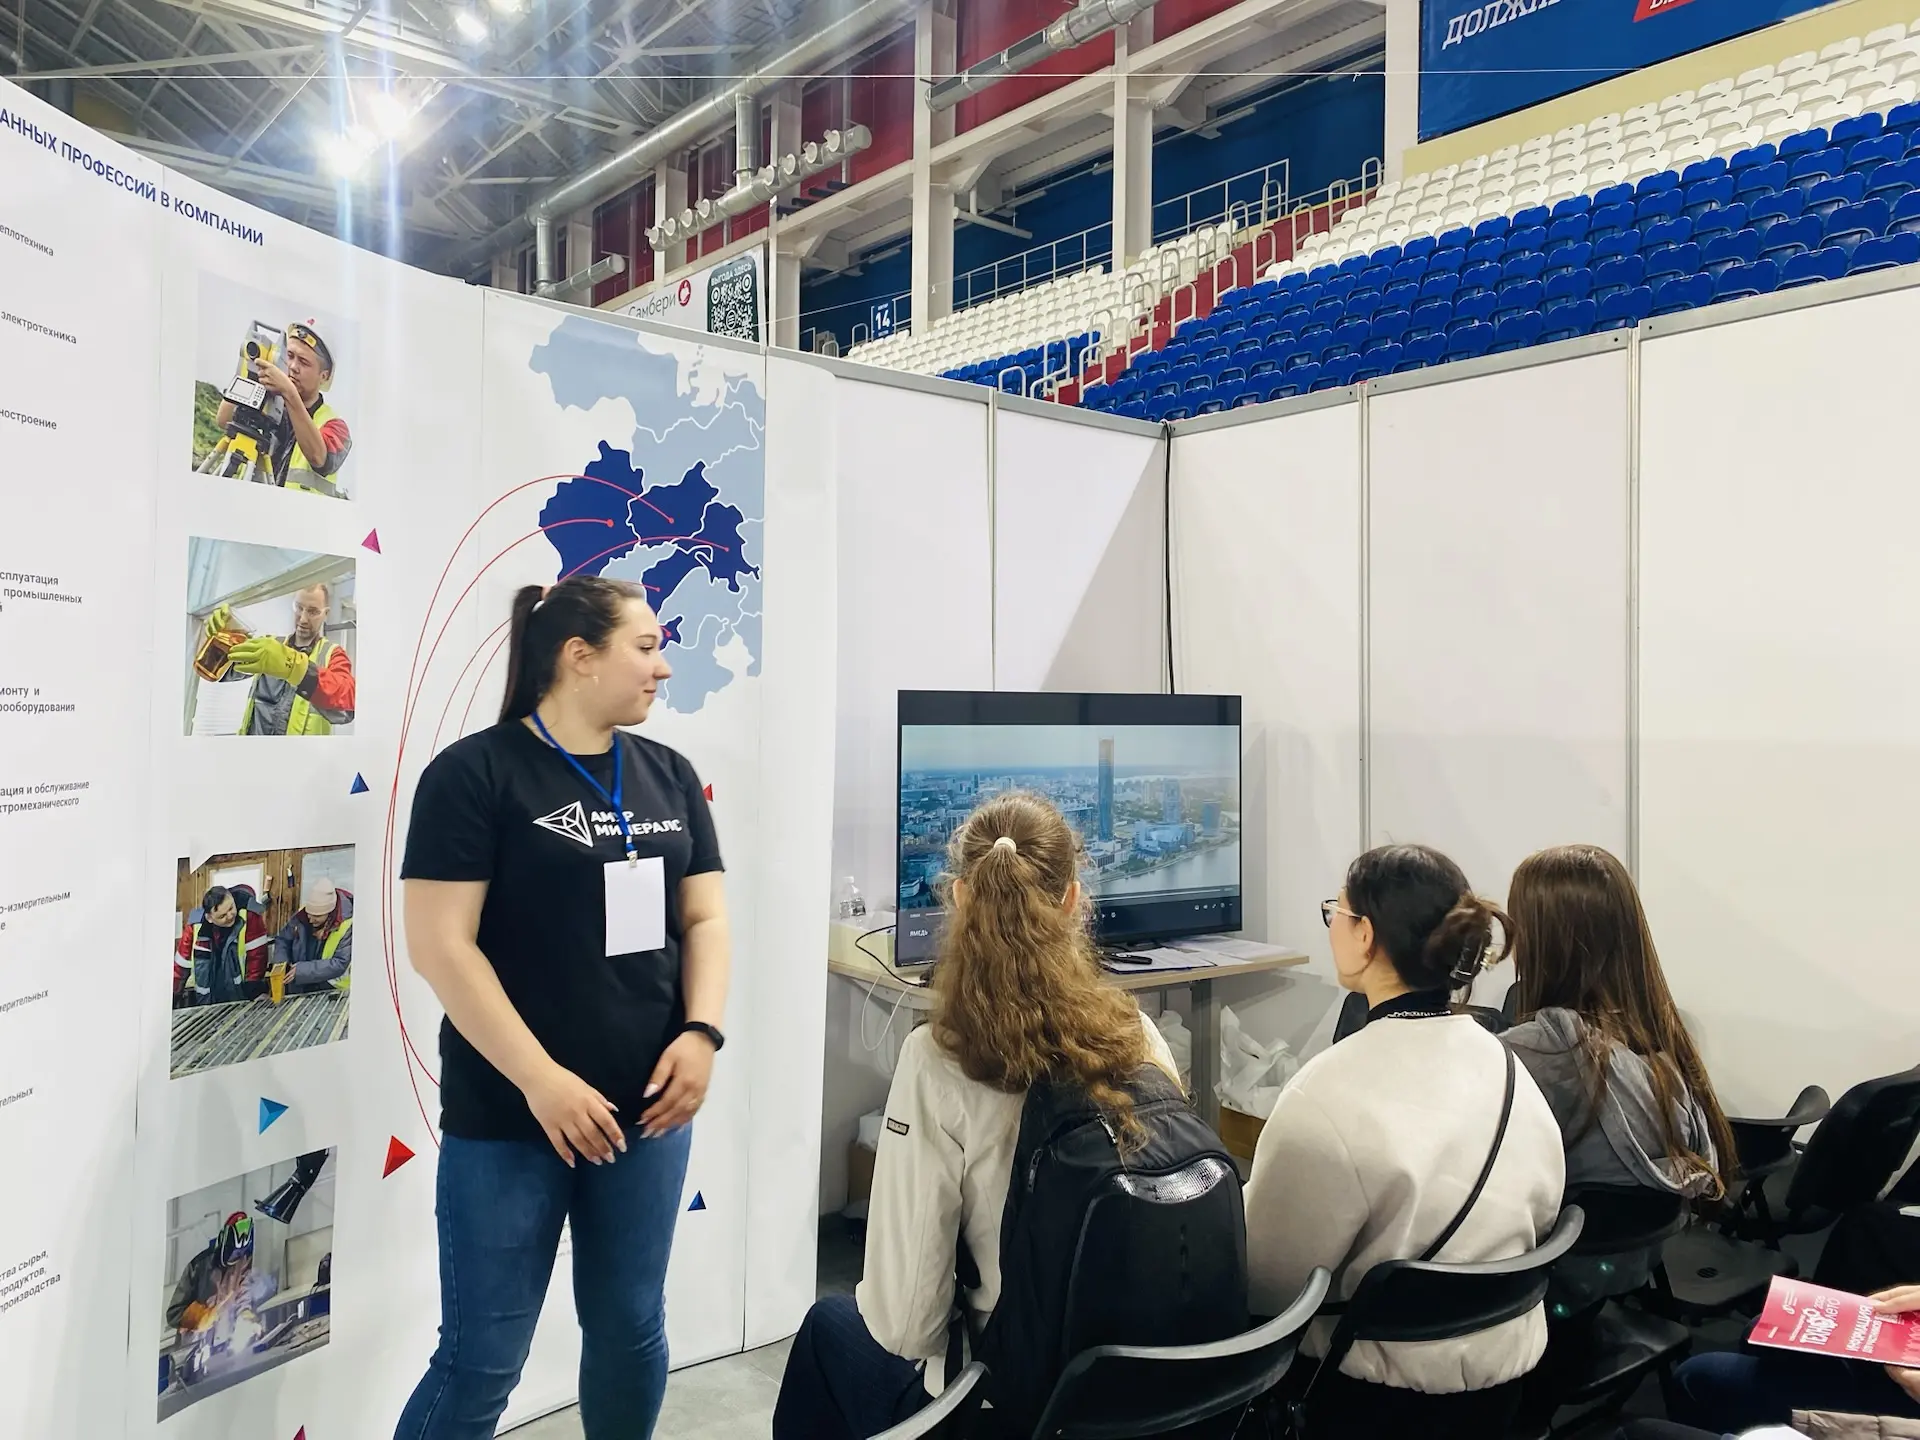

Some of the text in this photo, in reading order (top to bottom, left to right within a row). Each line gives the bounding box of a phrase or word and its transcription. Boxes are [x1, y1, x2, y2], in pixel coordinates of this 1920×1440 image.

[1442, 0, 1561, 50] ДОЛЖ
[0, 108, 264, 247] АННЫХ ПРОФЕССИЙ В КОМПАНИИ
[628, 293, 676, 318] Самбери
[1, 310, 77, 345] электротехника
[875, 309, 891, 330] 14
[4, 587, 82, 604] промышленных
[34, 687, 40, 696] и
[0, 780, 90, 798] ация и обслуживание
